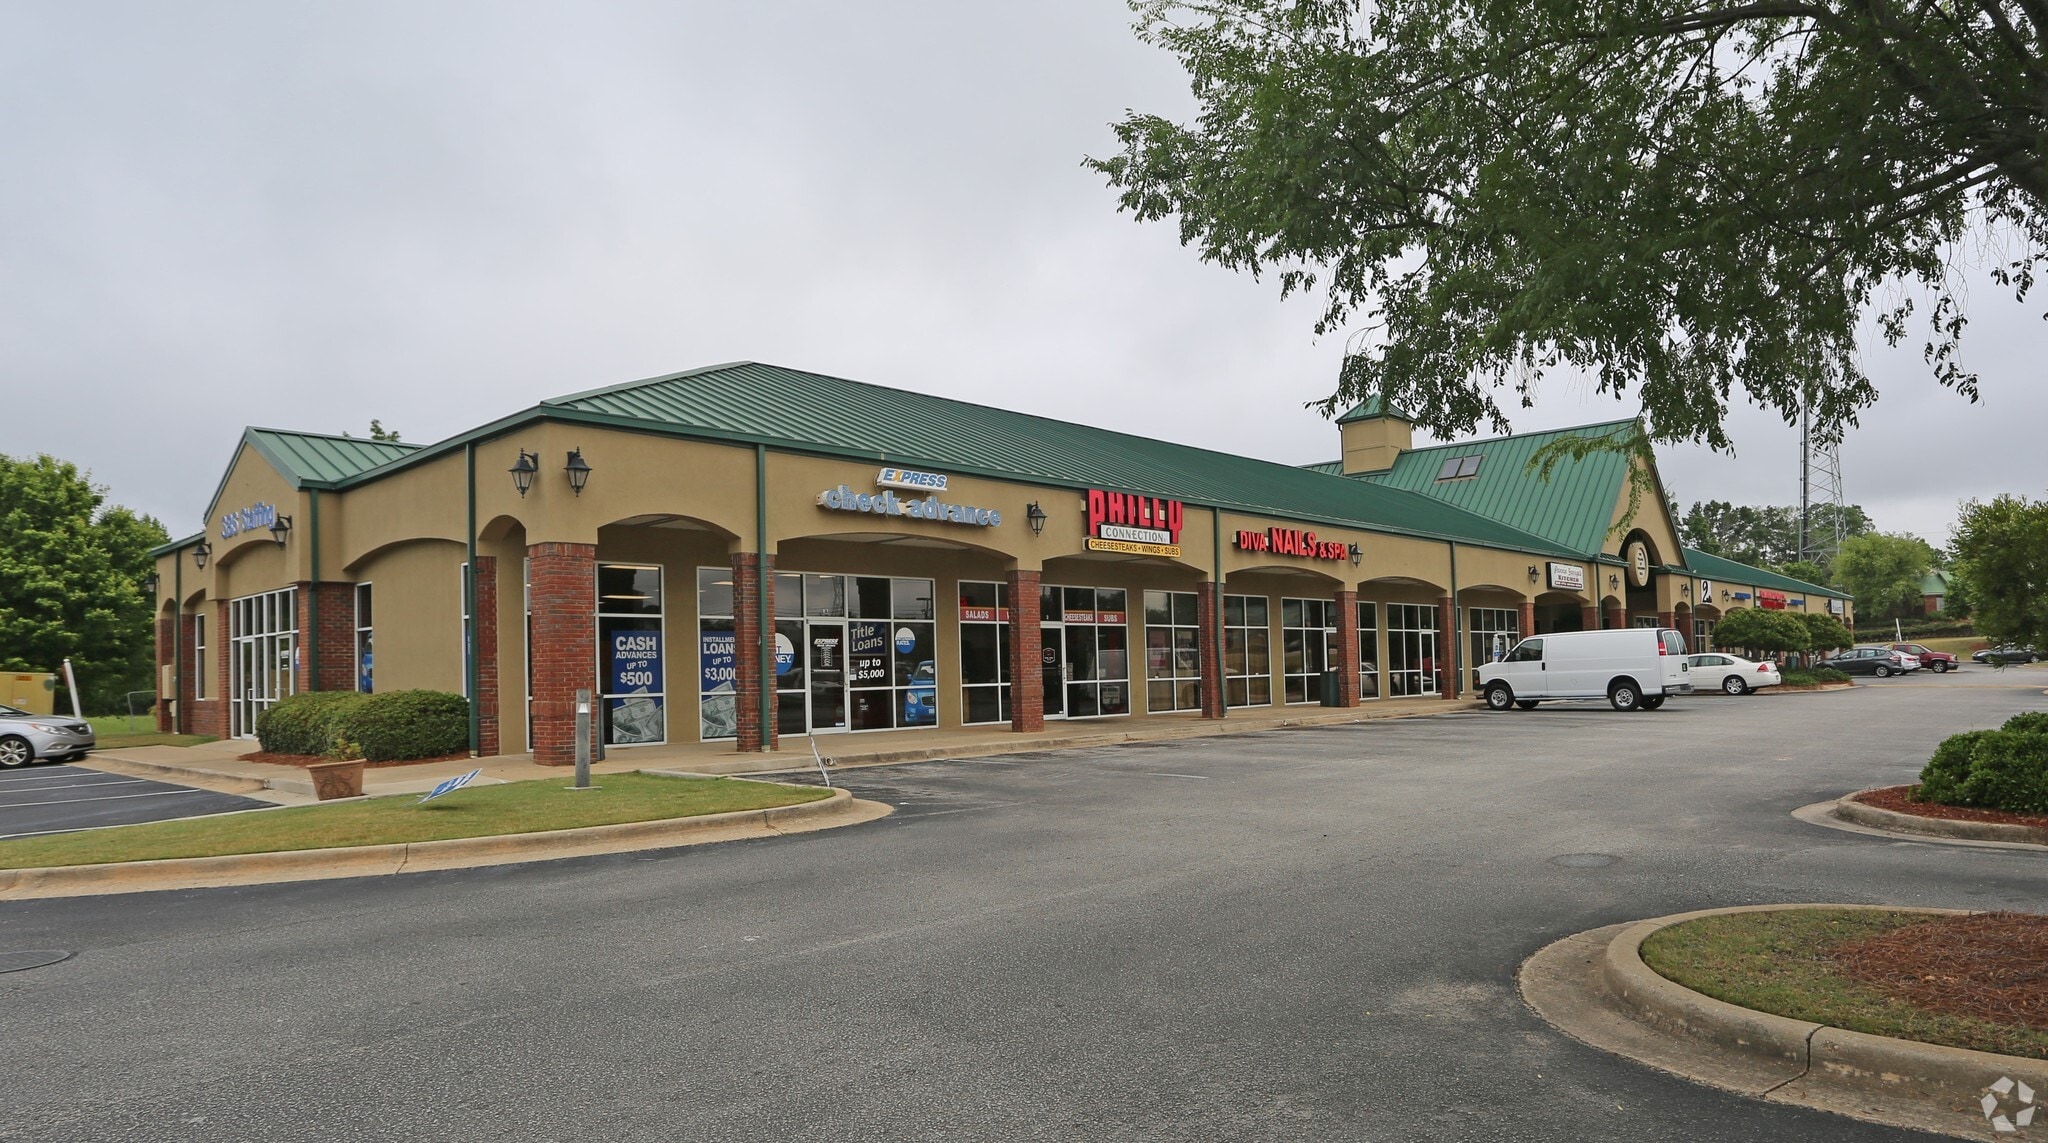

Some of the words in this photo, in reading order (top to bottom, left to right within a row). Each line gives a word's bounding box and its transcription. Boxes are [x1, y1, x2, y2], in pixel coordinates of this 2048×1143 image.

[883, 469, 946, 488] EXPRESS
[825, 484, 901, 515] check
[905, 495, 1001, 527] advance
[1089, 489, 1182, 544] PHILLY
[1105, 526, 1164, 543] CONNECTION
[1090, 540, 1137, 553] CHEESESTEAKS
[1142, 544, 1160, 554] WINGS
[1164, 547, 1179, 556] SUBS
[1240, 530, 1266, 551] DIVA
[1271, 527, 1317, 557] NAILS
[1319, 541, 1327, 558] &
[1327, 541, 1348, 560] SPA
[965, 610, 989, 619] SALADS
[1065, 613, 1093, 622] CHEESESTEAKS
[1103, 614, 1118, 622] SUBS
[850, 624, 875, 640] Title
[615, 636, 657, 651] CASH
[852, 636, 883, 652] Loans
[615, 651, 657, 659] ADVANCES
[626, 662, 637, 670] UP
[637, 660, 648, 668] TO
[859, 659, 871, 669] up
[872, 657, 882, 667] to
[620, 671, 653, 686] $500
[857, 669, 885, 680] $5,000
